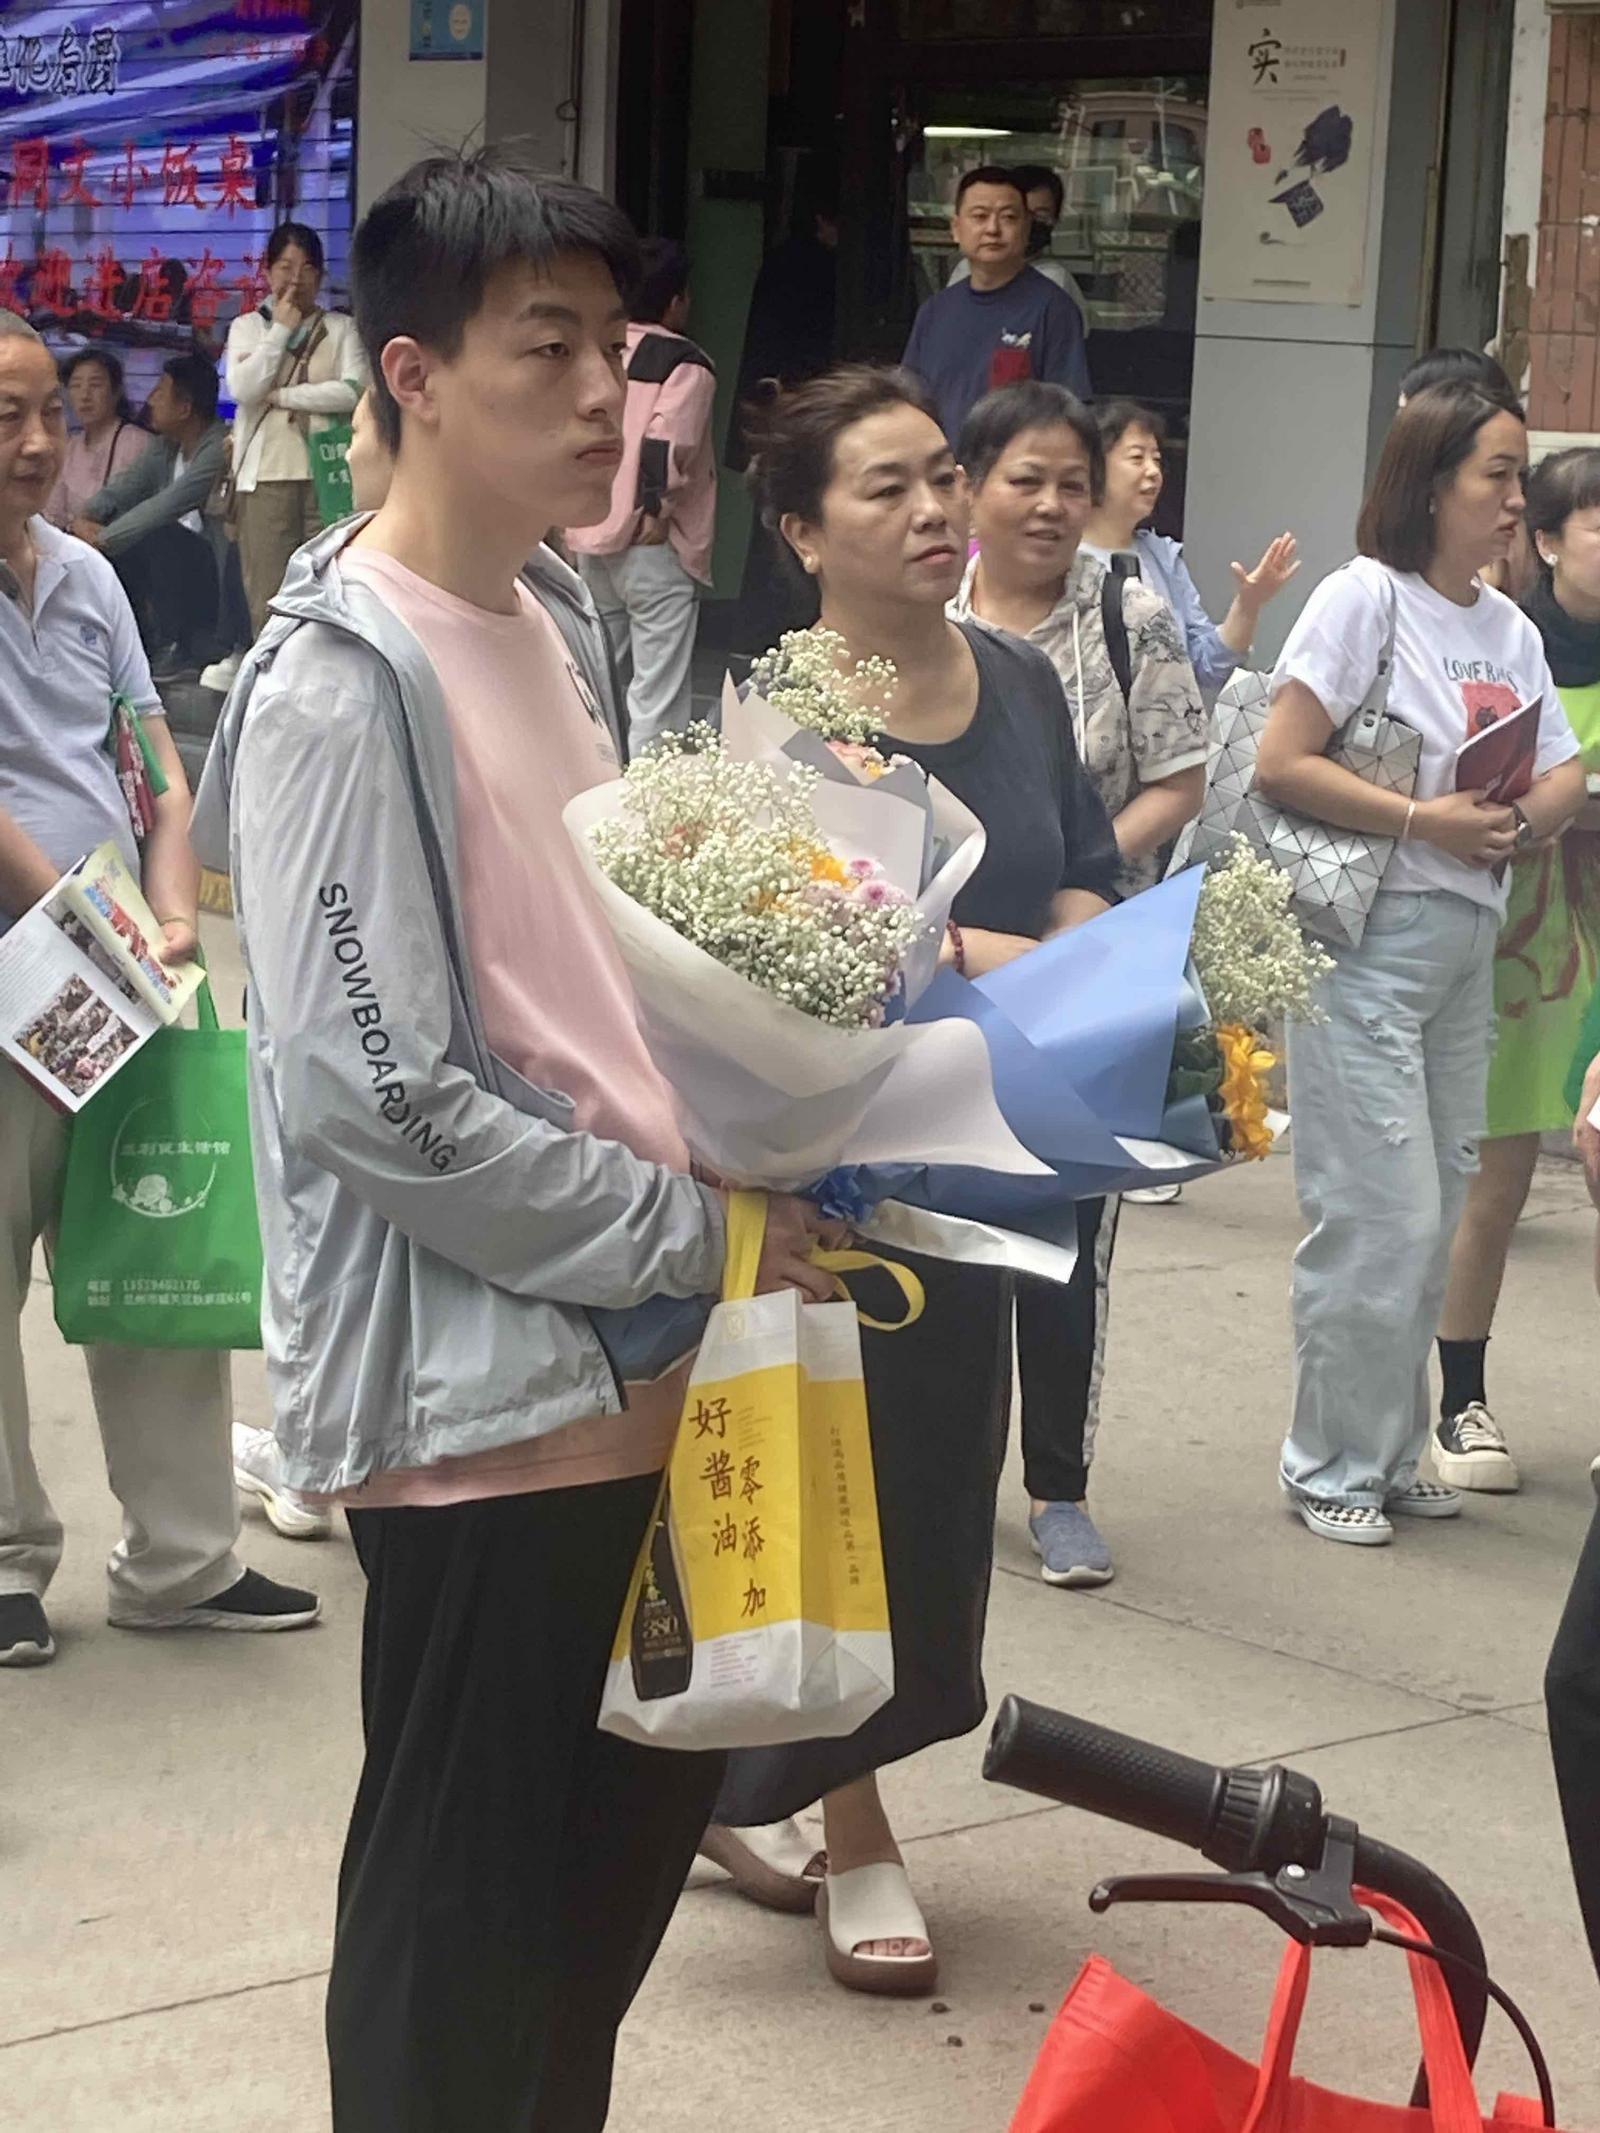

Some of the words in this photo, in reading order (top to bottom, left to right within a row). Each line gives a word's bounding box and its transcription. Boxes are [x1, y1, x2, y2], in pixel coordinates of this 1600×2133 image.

[0, 25, 117, 95] 化后厨
[1248, 27, 1282, 85] 实
[319, 882, 457, 1172] SNOWBOARDING
[688, 1397, 737, 1557] 好酱油
[739, 1455, 766, 1618] 零添加
